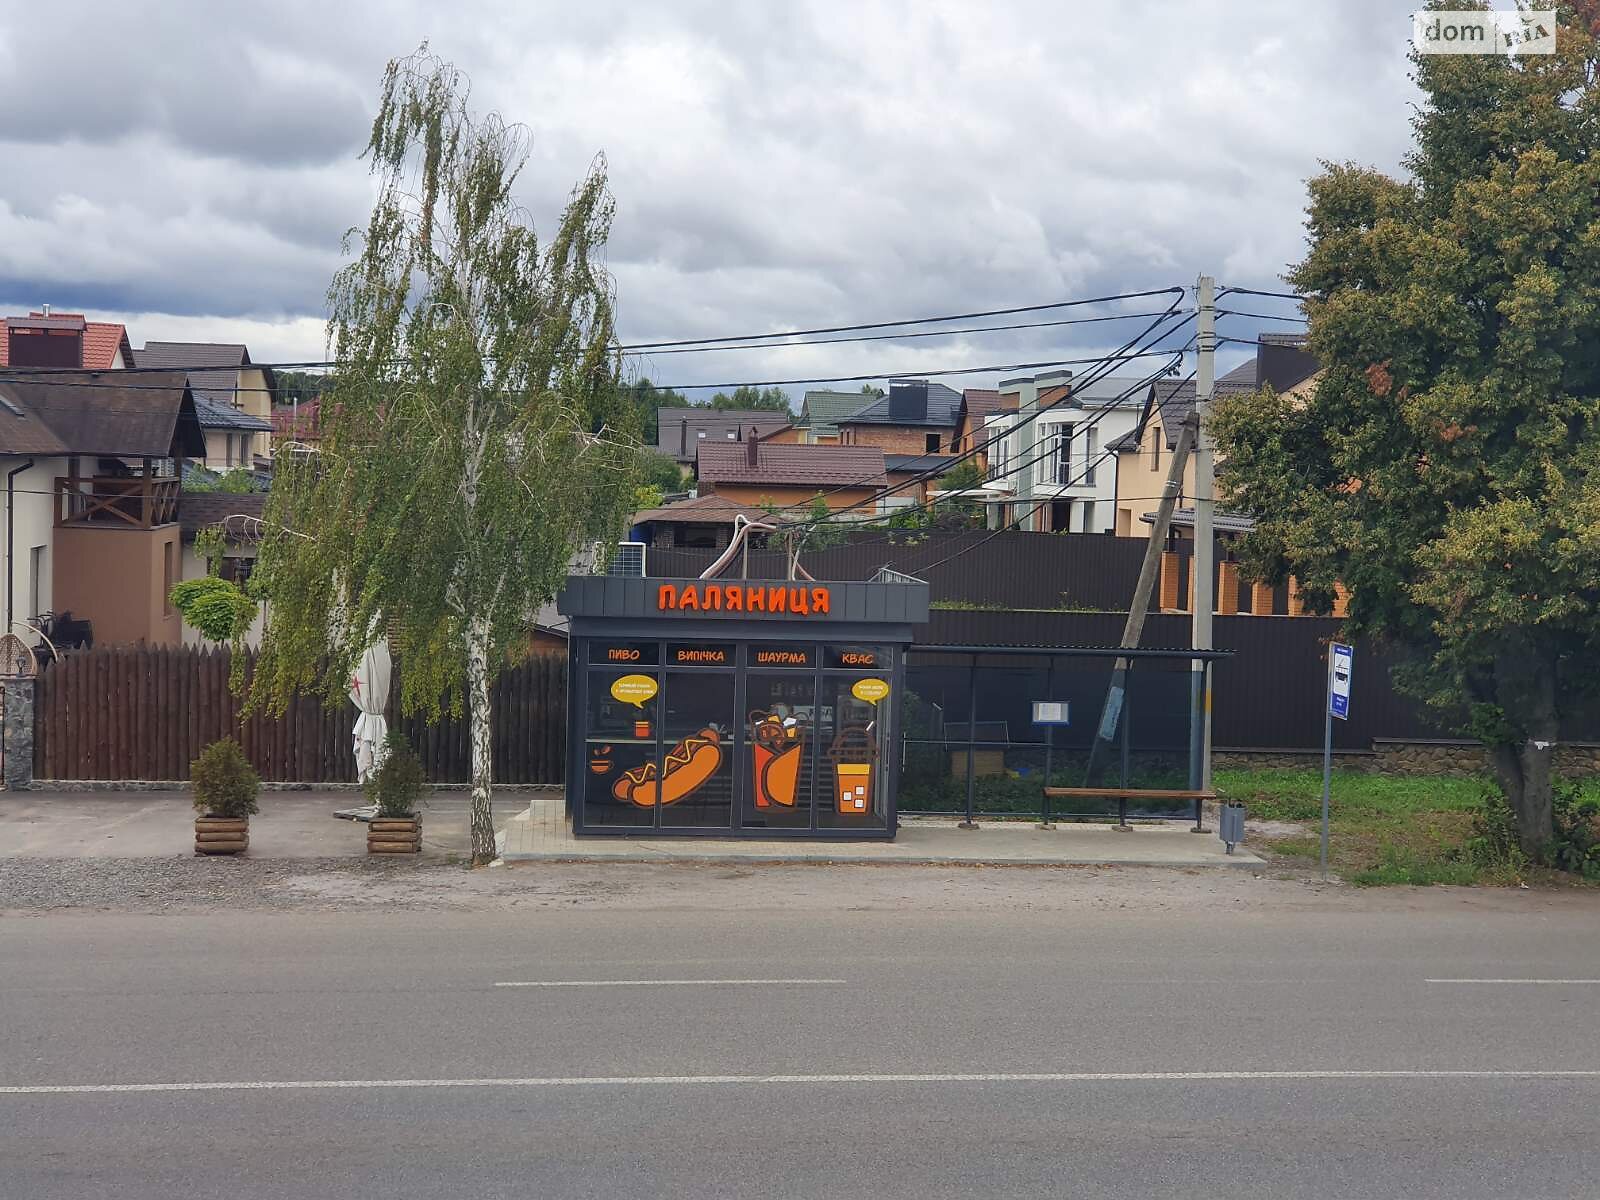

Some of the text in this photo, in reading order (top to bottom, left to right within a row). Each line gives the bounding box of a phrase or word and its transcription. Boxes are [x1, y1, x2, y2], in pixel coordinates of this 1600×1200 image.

[658, 584, 830, 616] ПАЛЯНИЦЯ
[608, 649, 640, 660] ПИВО
[677, 651, 725, 661] ВИПІЧКА
[757, 652, 807, 663] ШАУРМА
[841, 653, 874, 665] КВАС
